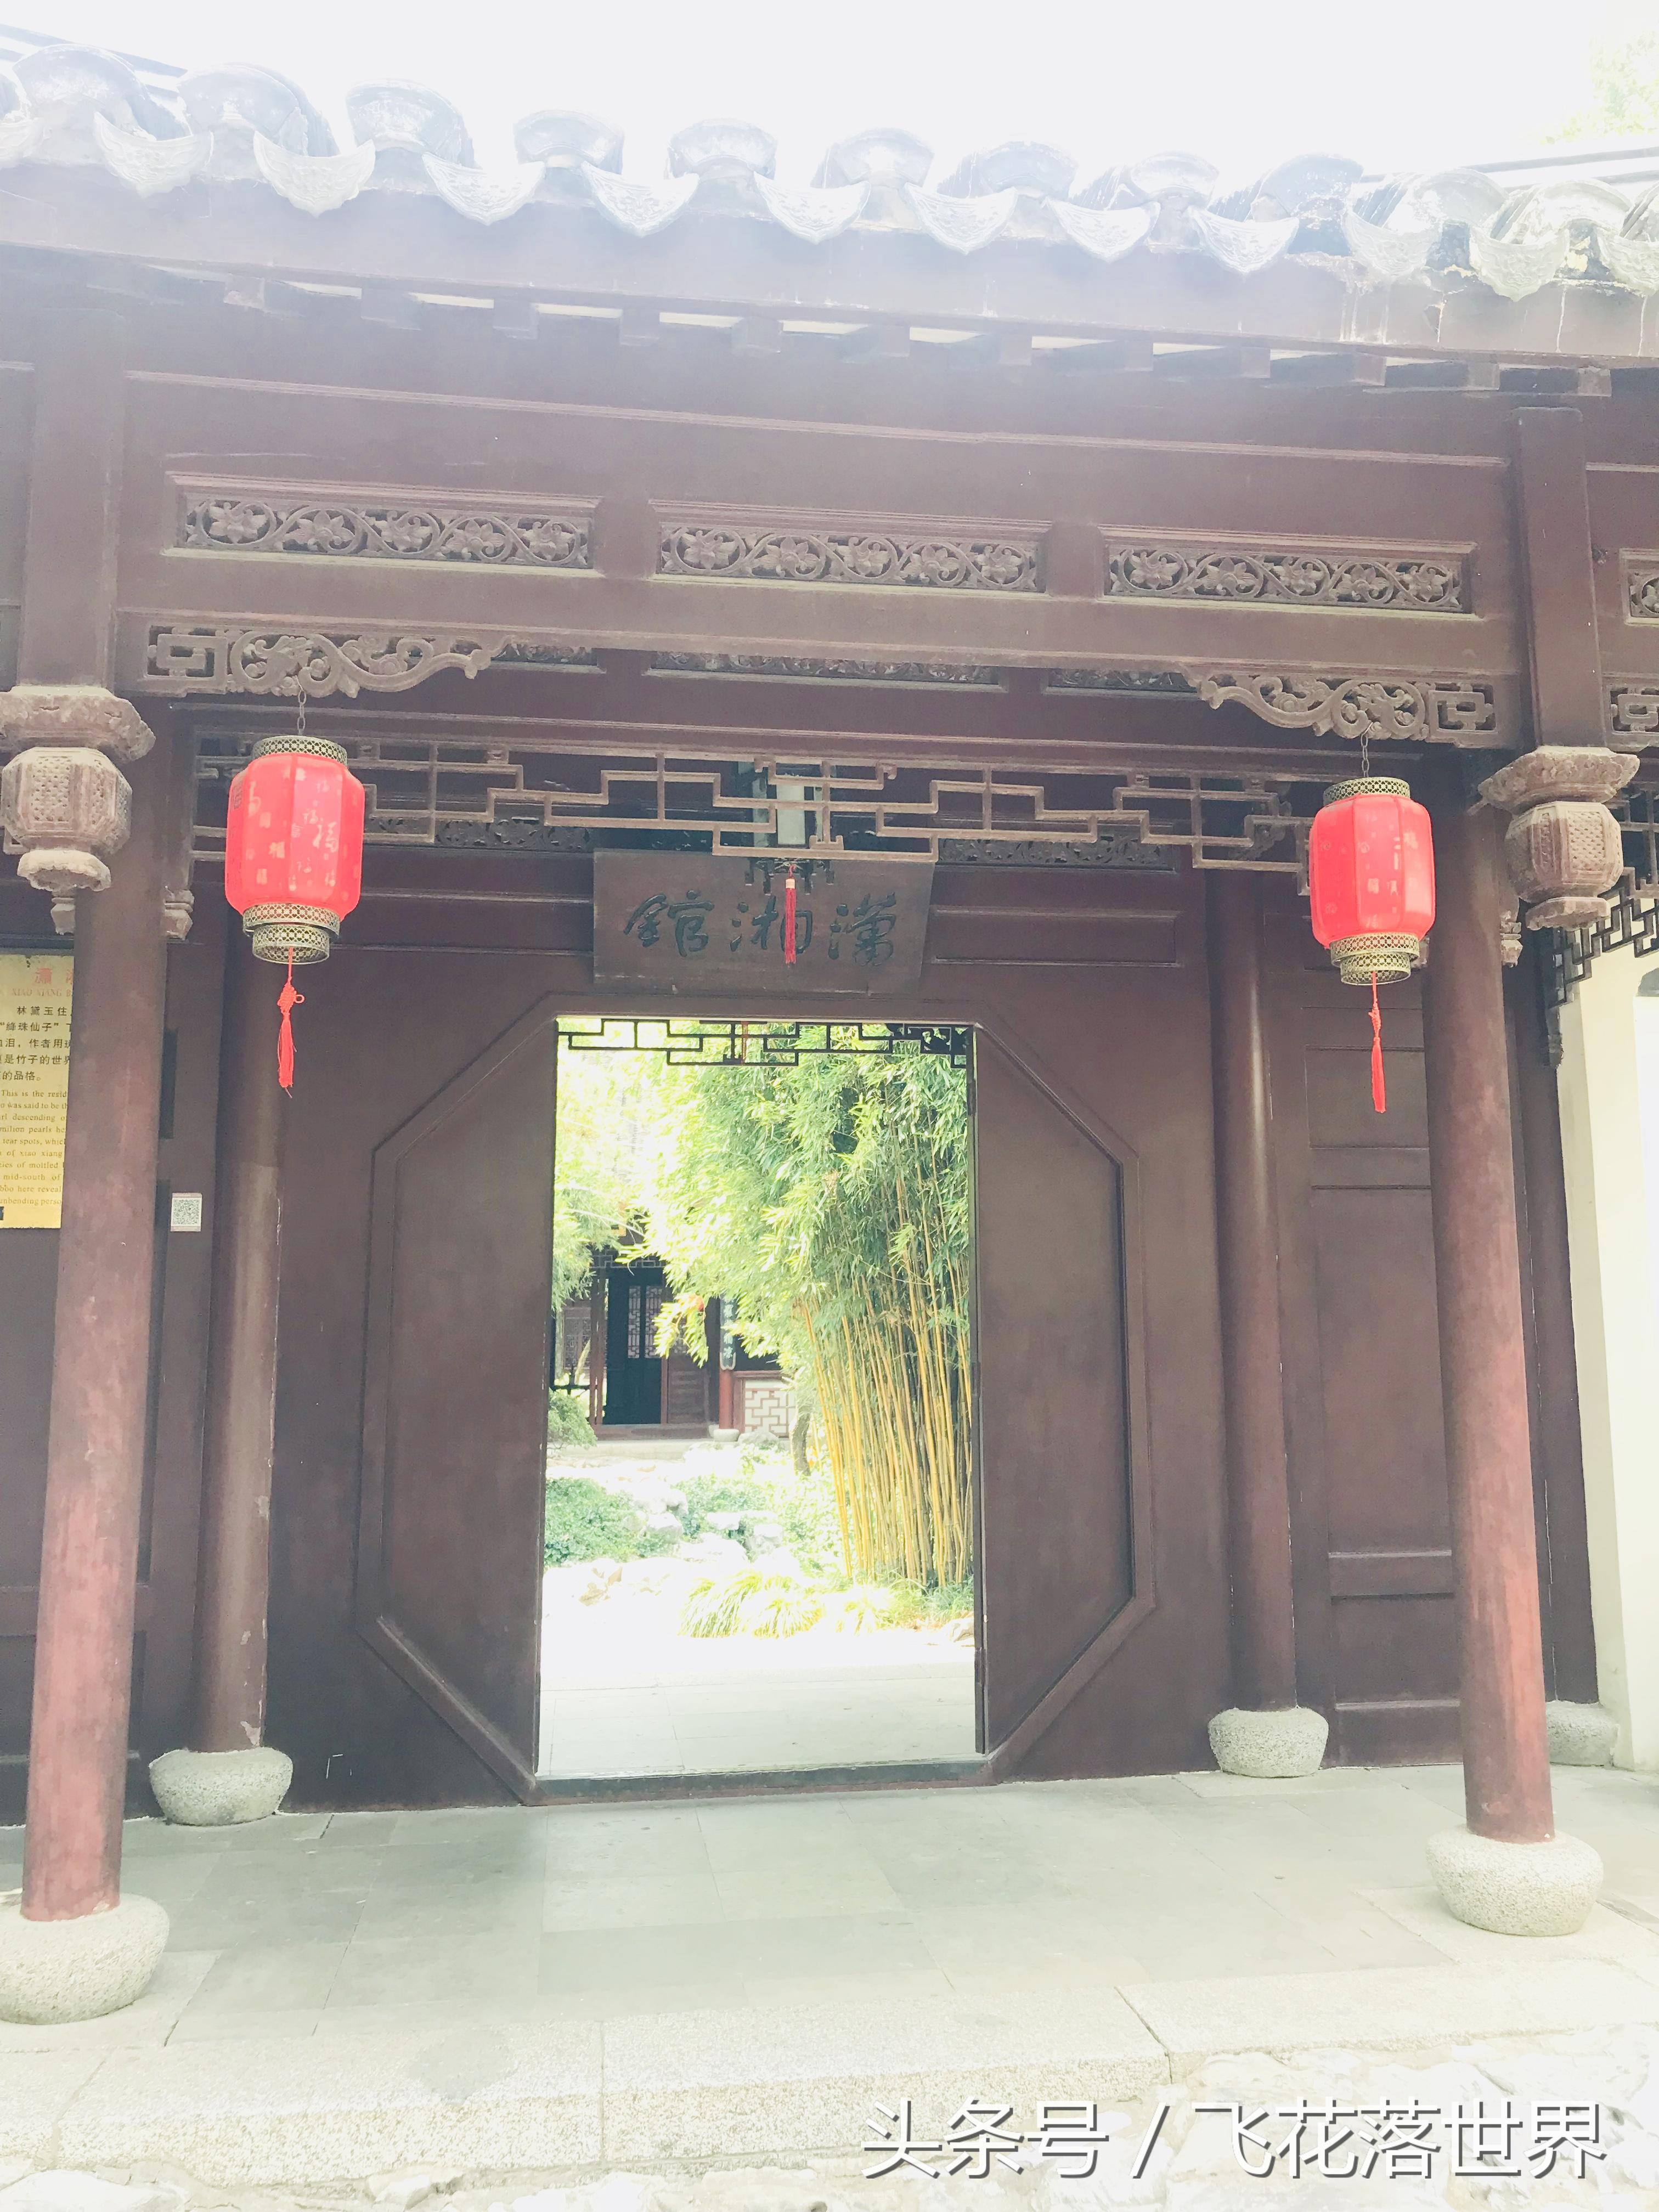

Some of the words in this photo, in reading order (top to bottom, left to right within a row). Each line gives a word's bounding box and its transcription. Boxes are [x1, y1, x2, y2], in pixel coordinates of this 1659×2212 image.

[0, 1054, 70, 1065] 是竹子的世界
[0, 1071, 41, 1081] 的品格。
[13, 1113, 55, 1122] descending
